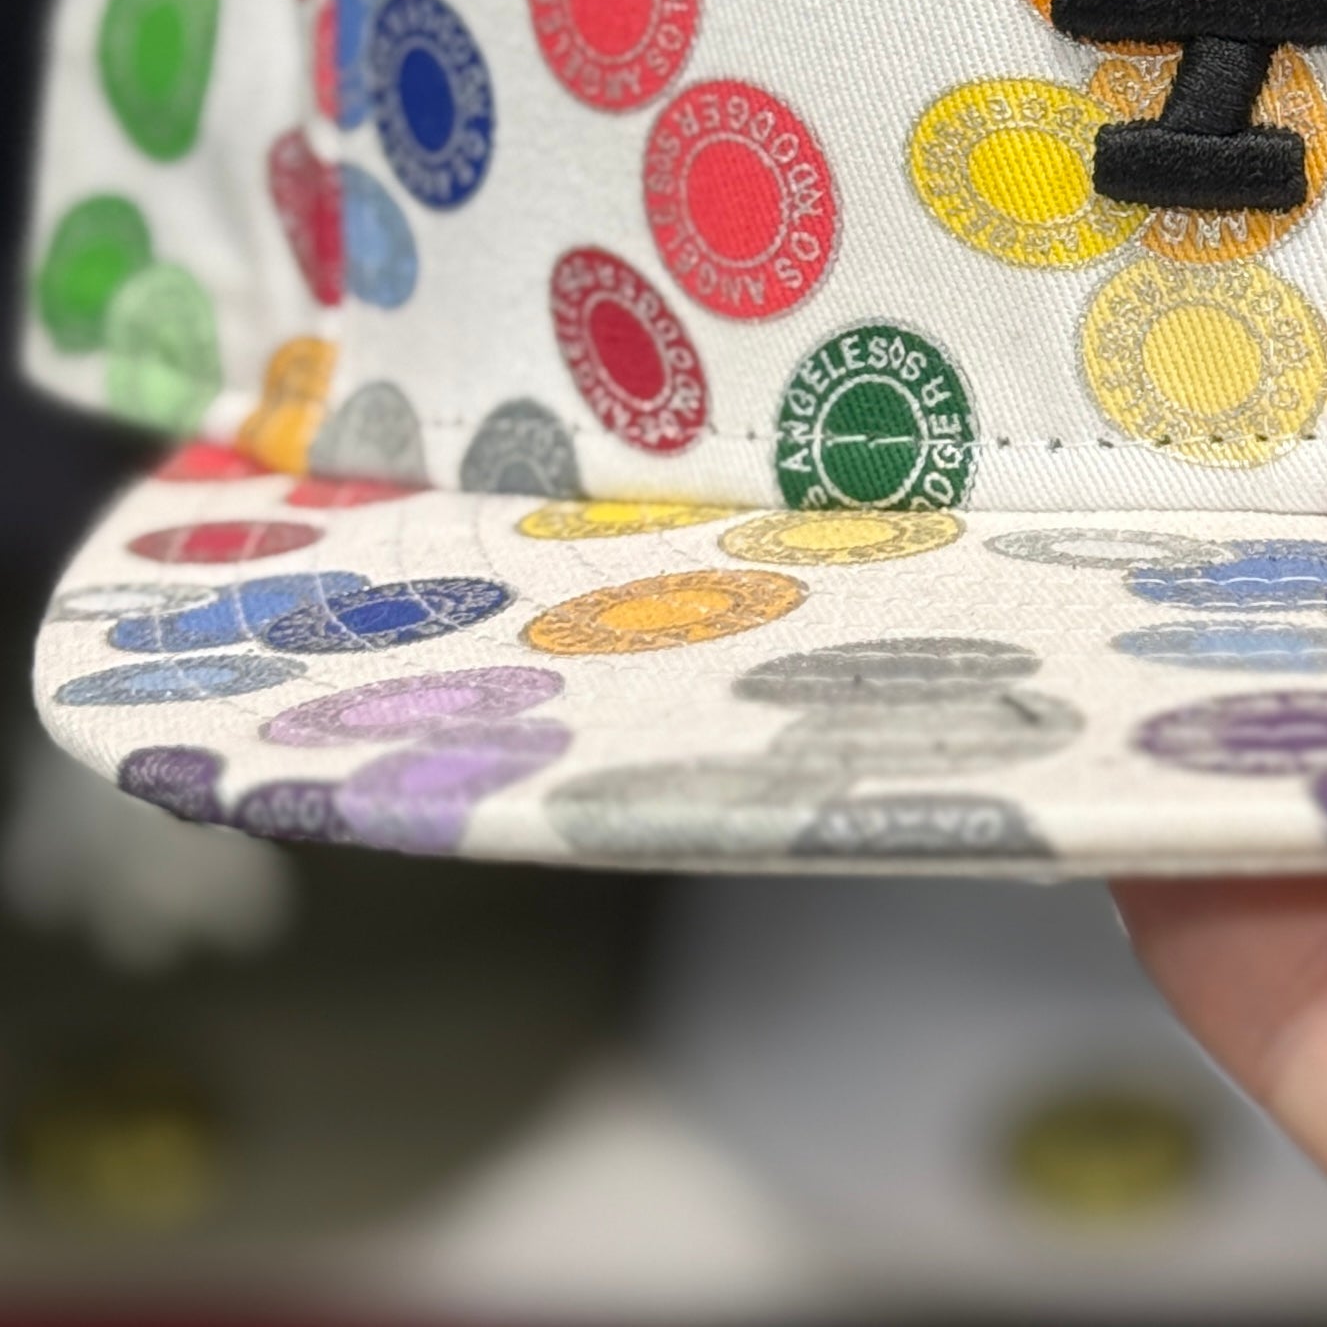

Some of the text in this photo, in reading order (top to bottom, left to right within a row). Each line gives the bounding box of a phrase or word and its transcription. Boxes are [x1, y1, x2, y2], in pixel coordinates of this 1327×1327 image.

[646, 0, 689, 73] LOS
[654, 94, 821, 186] DODGERS
[779, 334, 889, 473] ANGELES
[901, 351, 963, 509] DGERS
